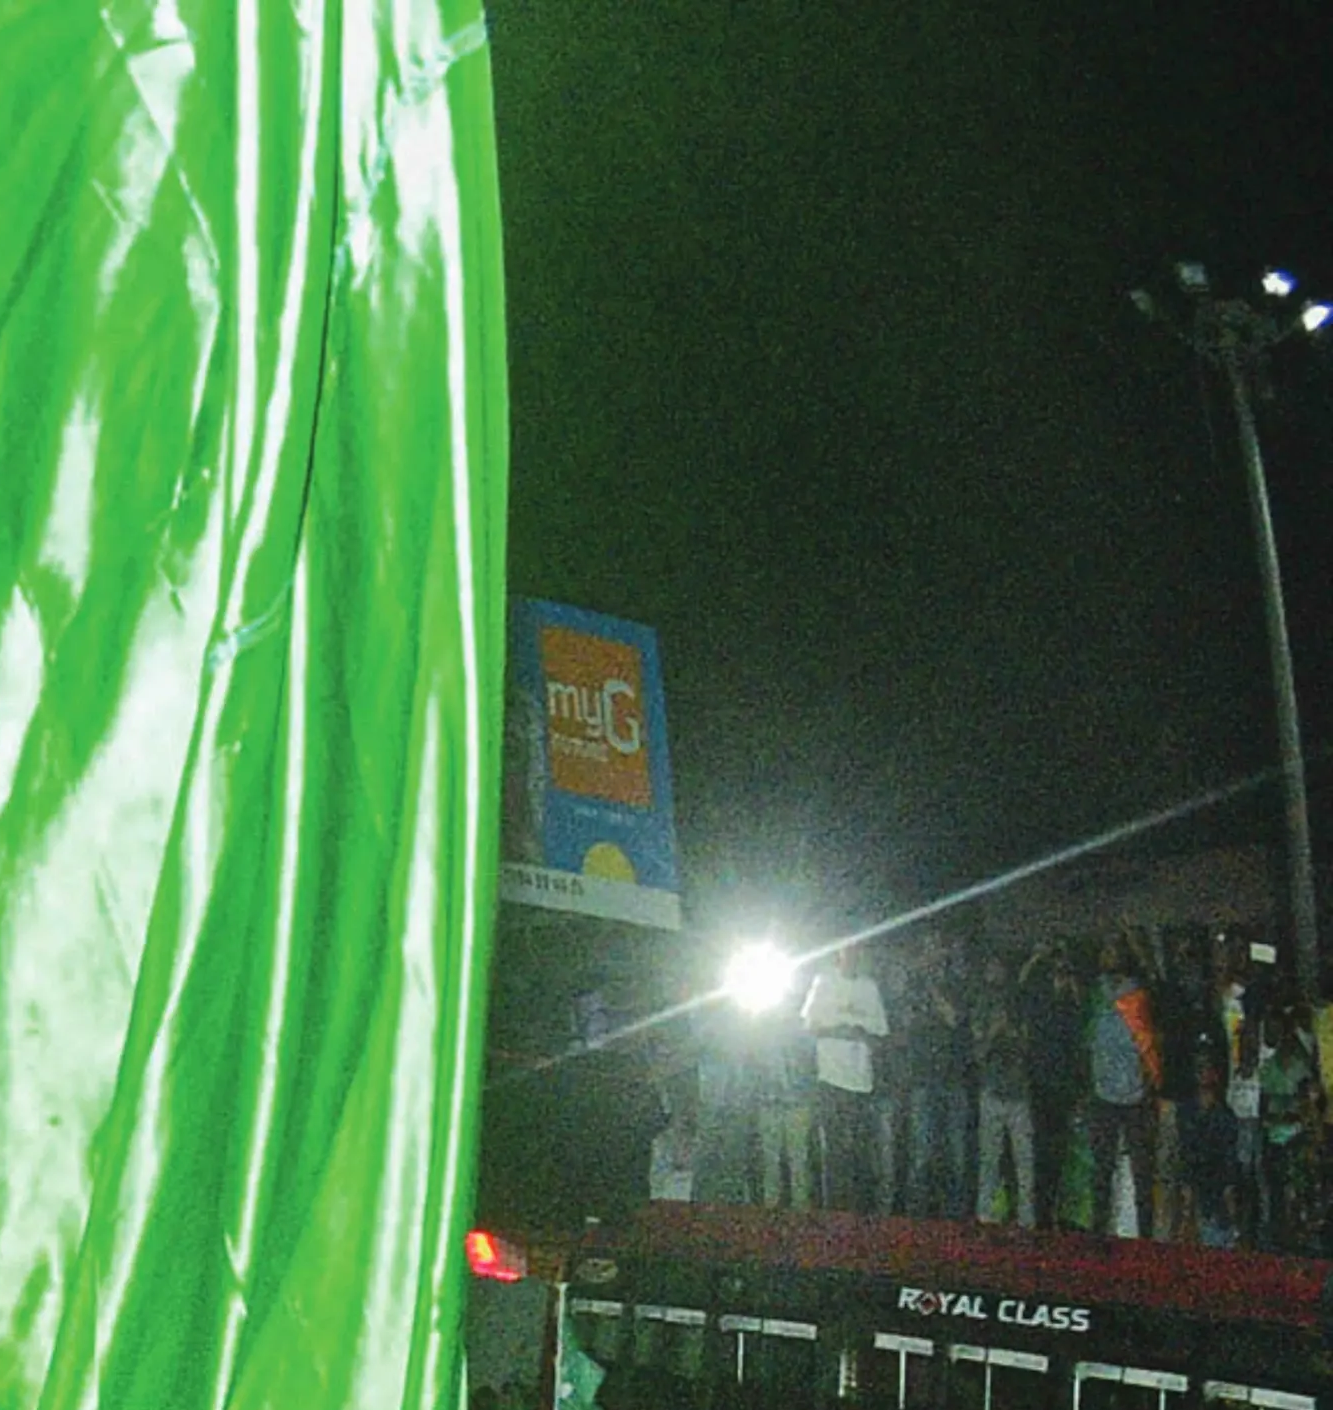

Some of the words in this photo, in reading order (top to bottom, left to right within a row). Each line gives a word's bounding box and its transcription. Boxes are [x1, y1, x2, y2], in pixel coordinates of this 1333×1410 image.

[546, 679, 639, 754] myG
[898, 1287, 988, 1319] ROYAL
[997, 1300, 1091, 1332] CLASS
